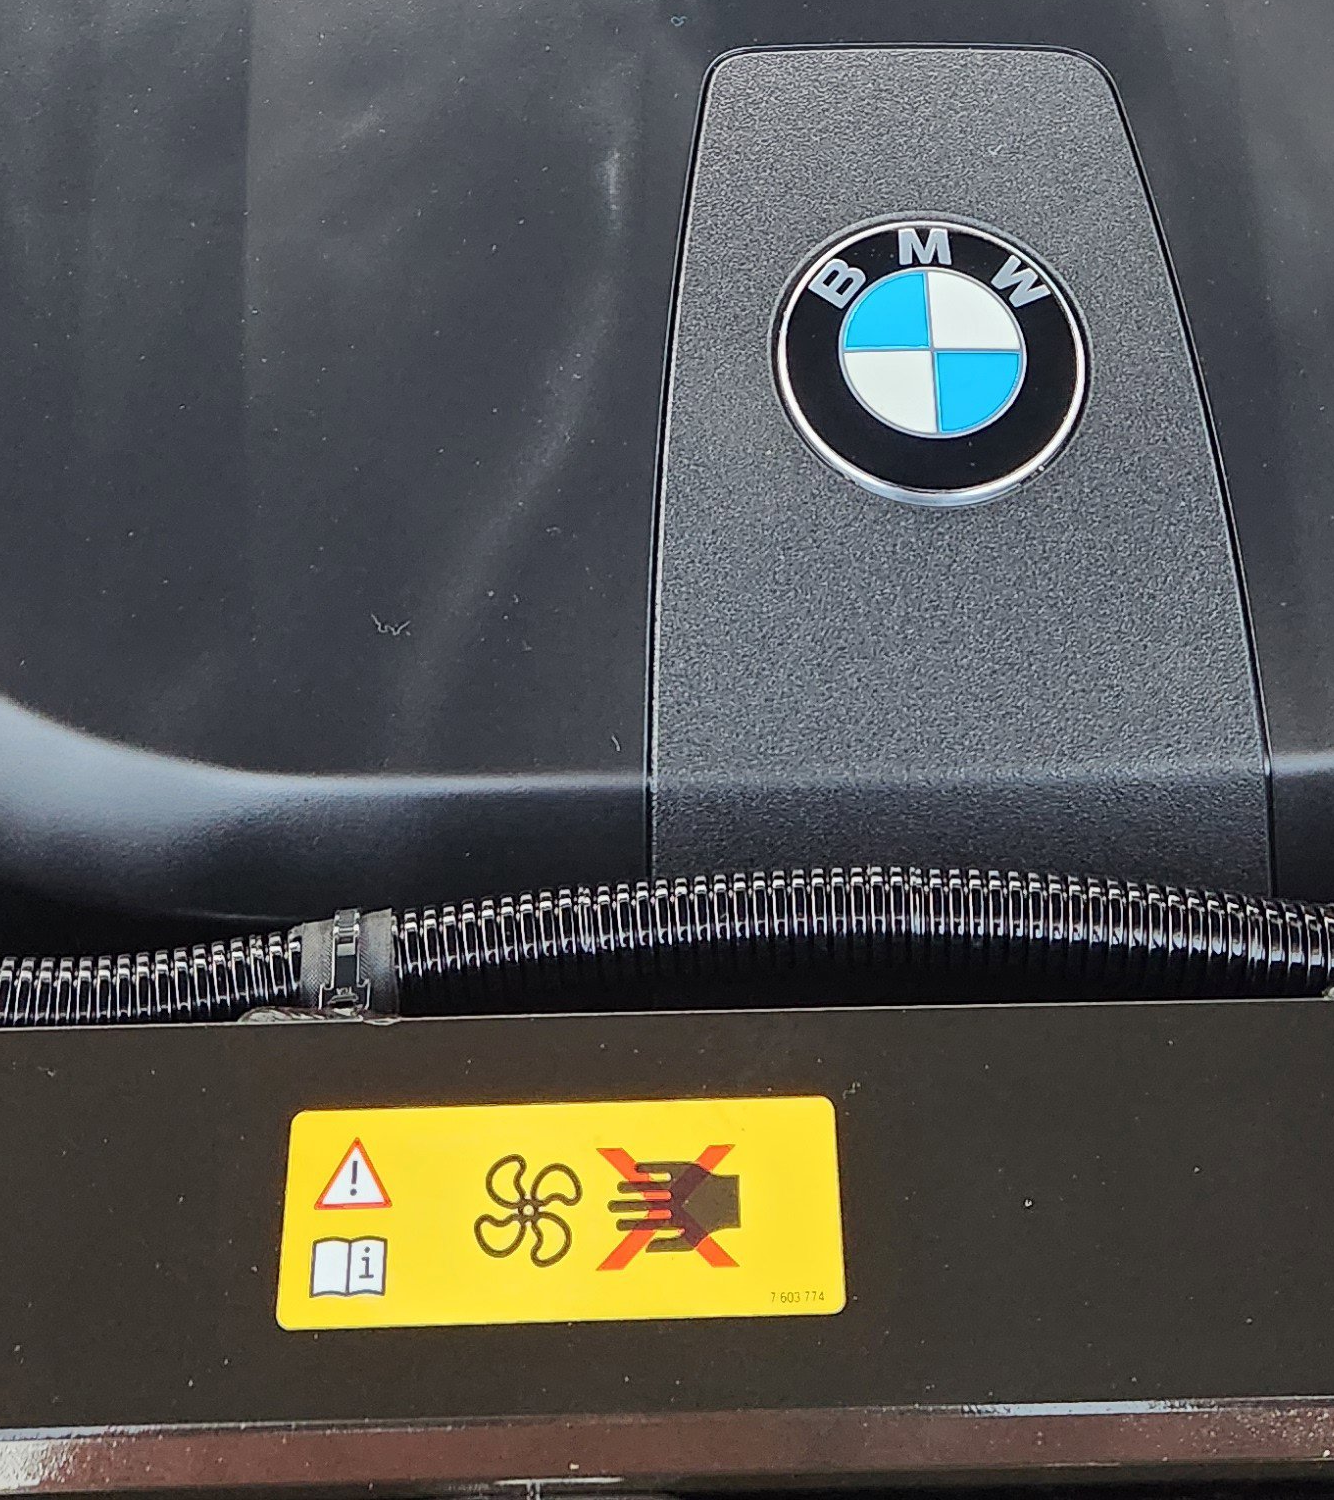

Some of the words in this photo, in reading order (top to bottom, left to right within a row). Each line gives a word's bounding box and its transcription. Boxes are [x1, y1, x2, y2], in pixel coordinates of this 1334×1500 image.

[808, 228, 1052, 309] BMW
[780, 1291, 801, 1304] 603
[804, 1290, 825, 1302] 774
